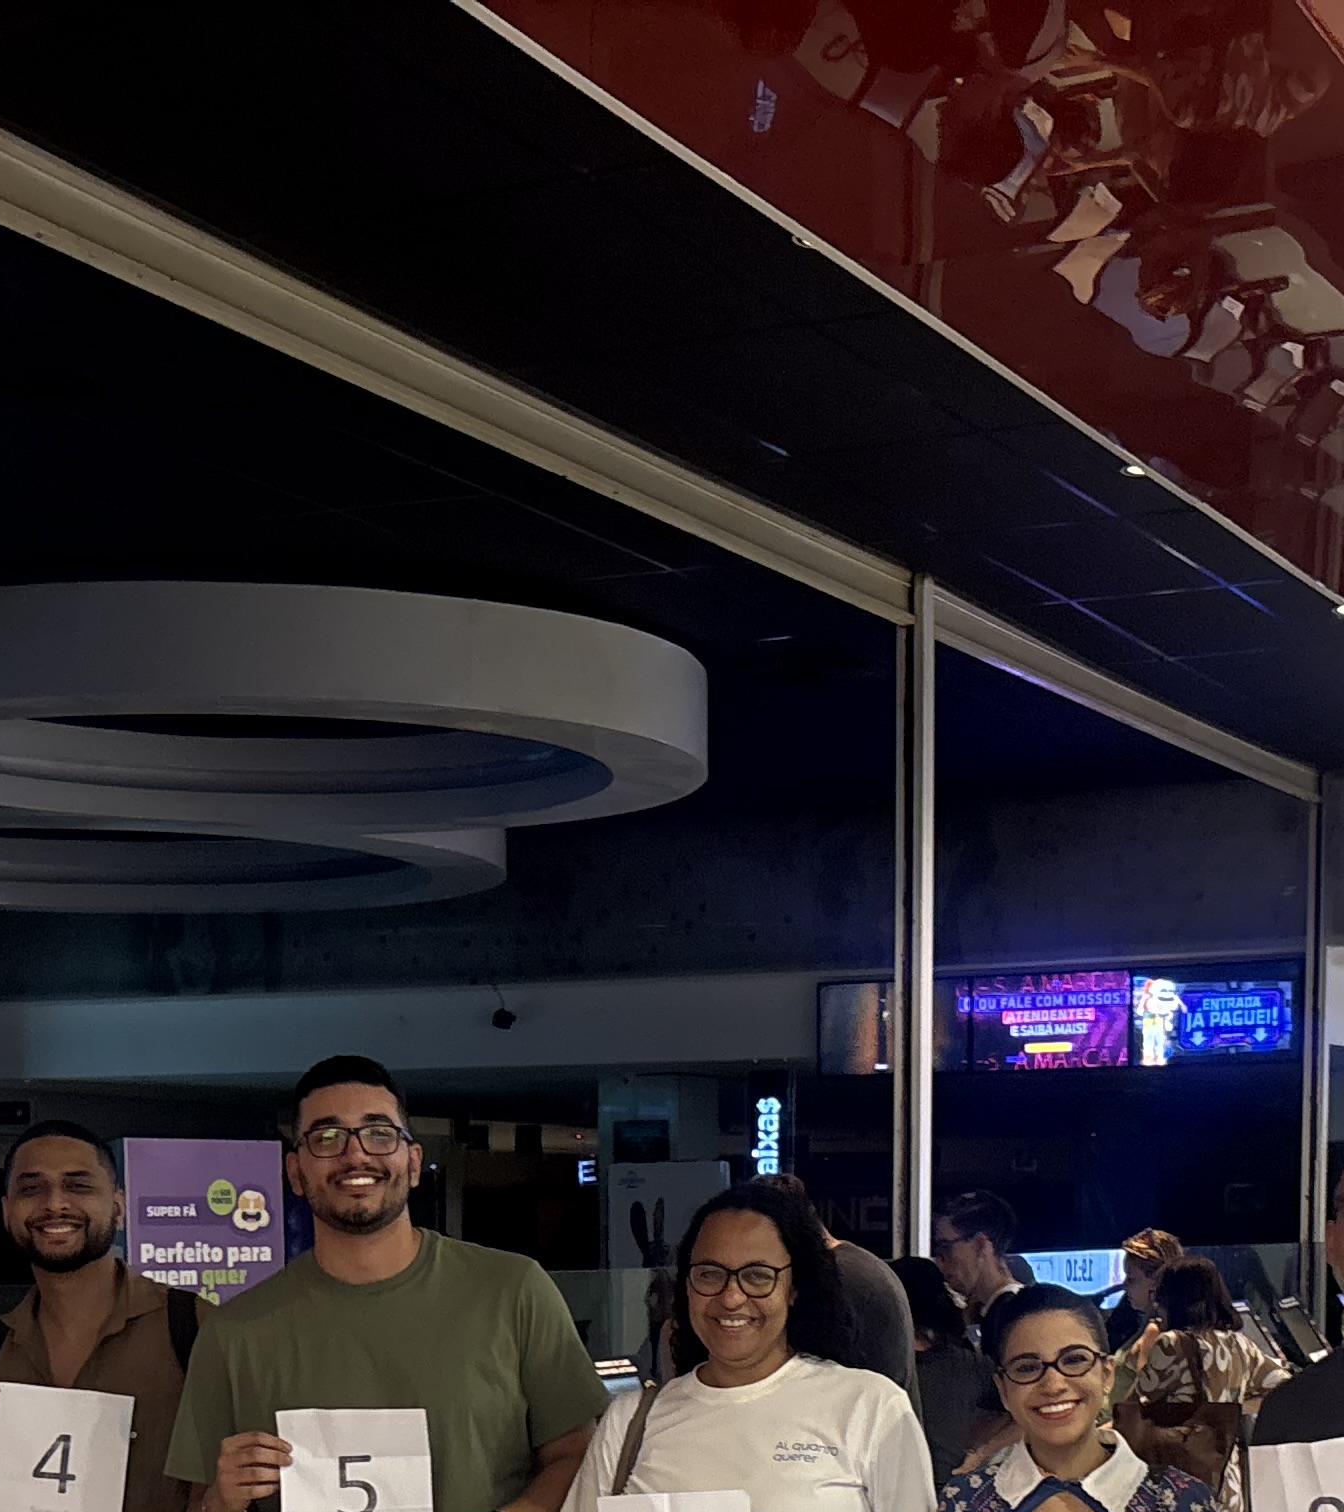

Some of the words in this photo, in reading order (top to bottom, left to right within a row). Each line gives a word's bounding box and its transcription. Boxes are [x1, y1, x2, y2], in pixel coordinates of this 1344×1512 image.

[1001, 997, 1032, 1009] FALE
[1036, 995, 1063, 1007] COM
[1068, 993, 1121, 1006] NOSSOS
[1202, 996, 1262, 1010] ENTRADA
[1006, 1010, 1092, 1023] ATENDENTES
[1186, 1008, 1205, 1032] JÁ
[1209, 1006, 1279, 1027] PAGUEI!
[751, 1096, 782, 1175] aixas
[146, 1205, 182, 1218] SUPER
[183, 1203, 198, 1218] FÃ
[140, 1241, 224, 1264] Perfeito
[226, 1245, 273, 1268] para
[201, 1269, 248, 1291] quer
[33, 1435, 76, 1493] 4
